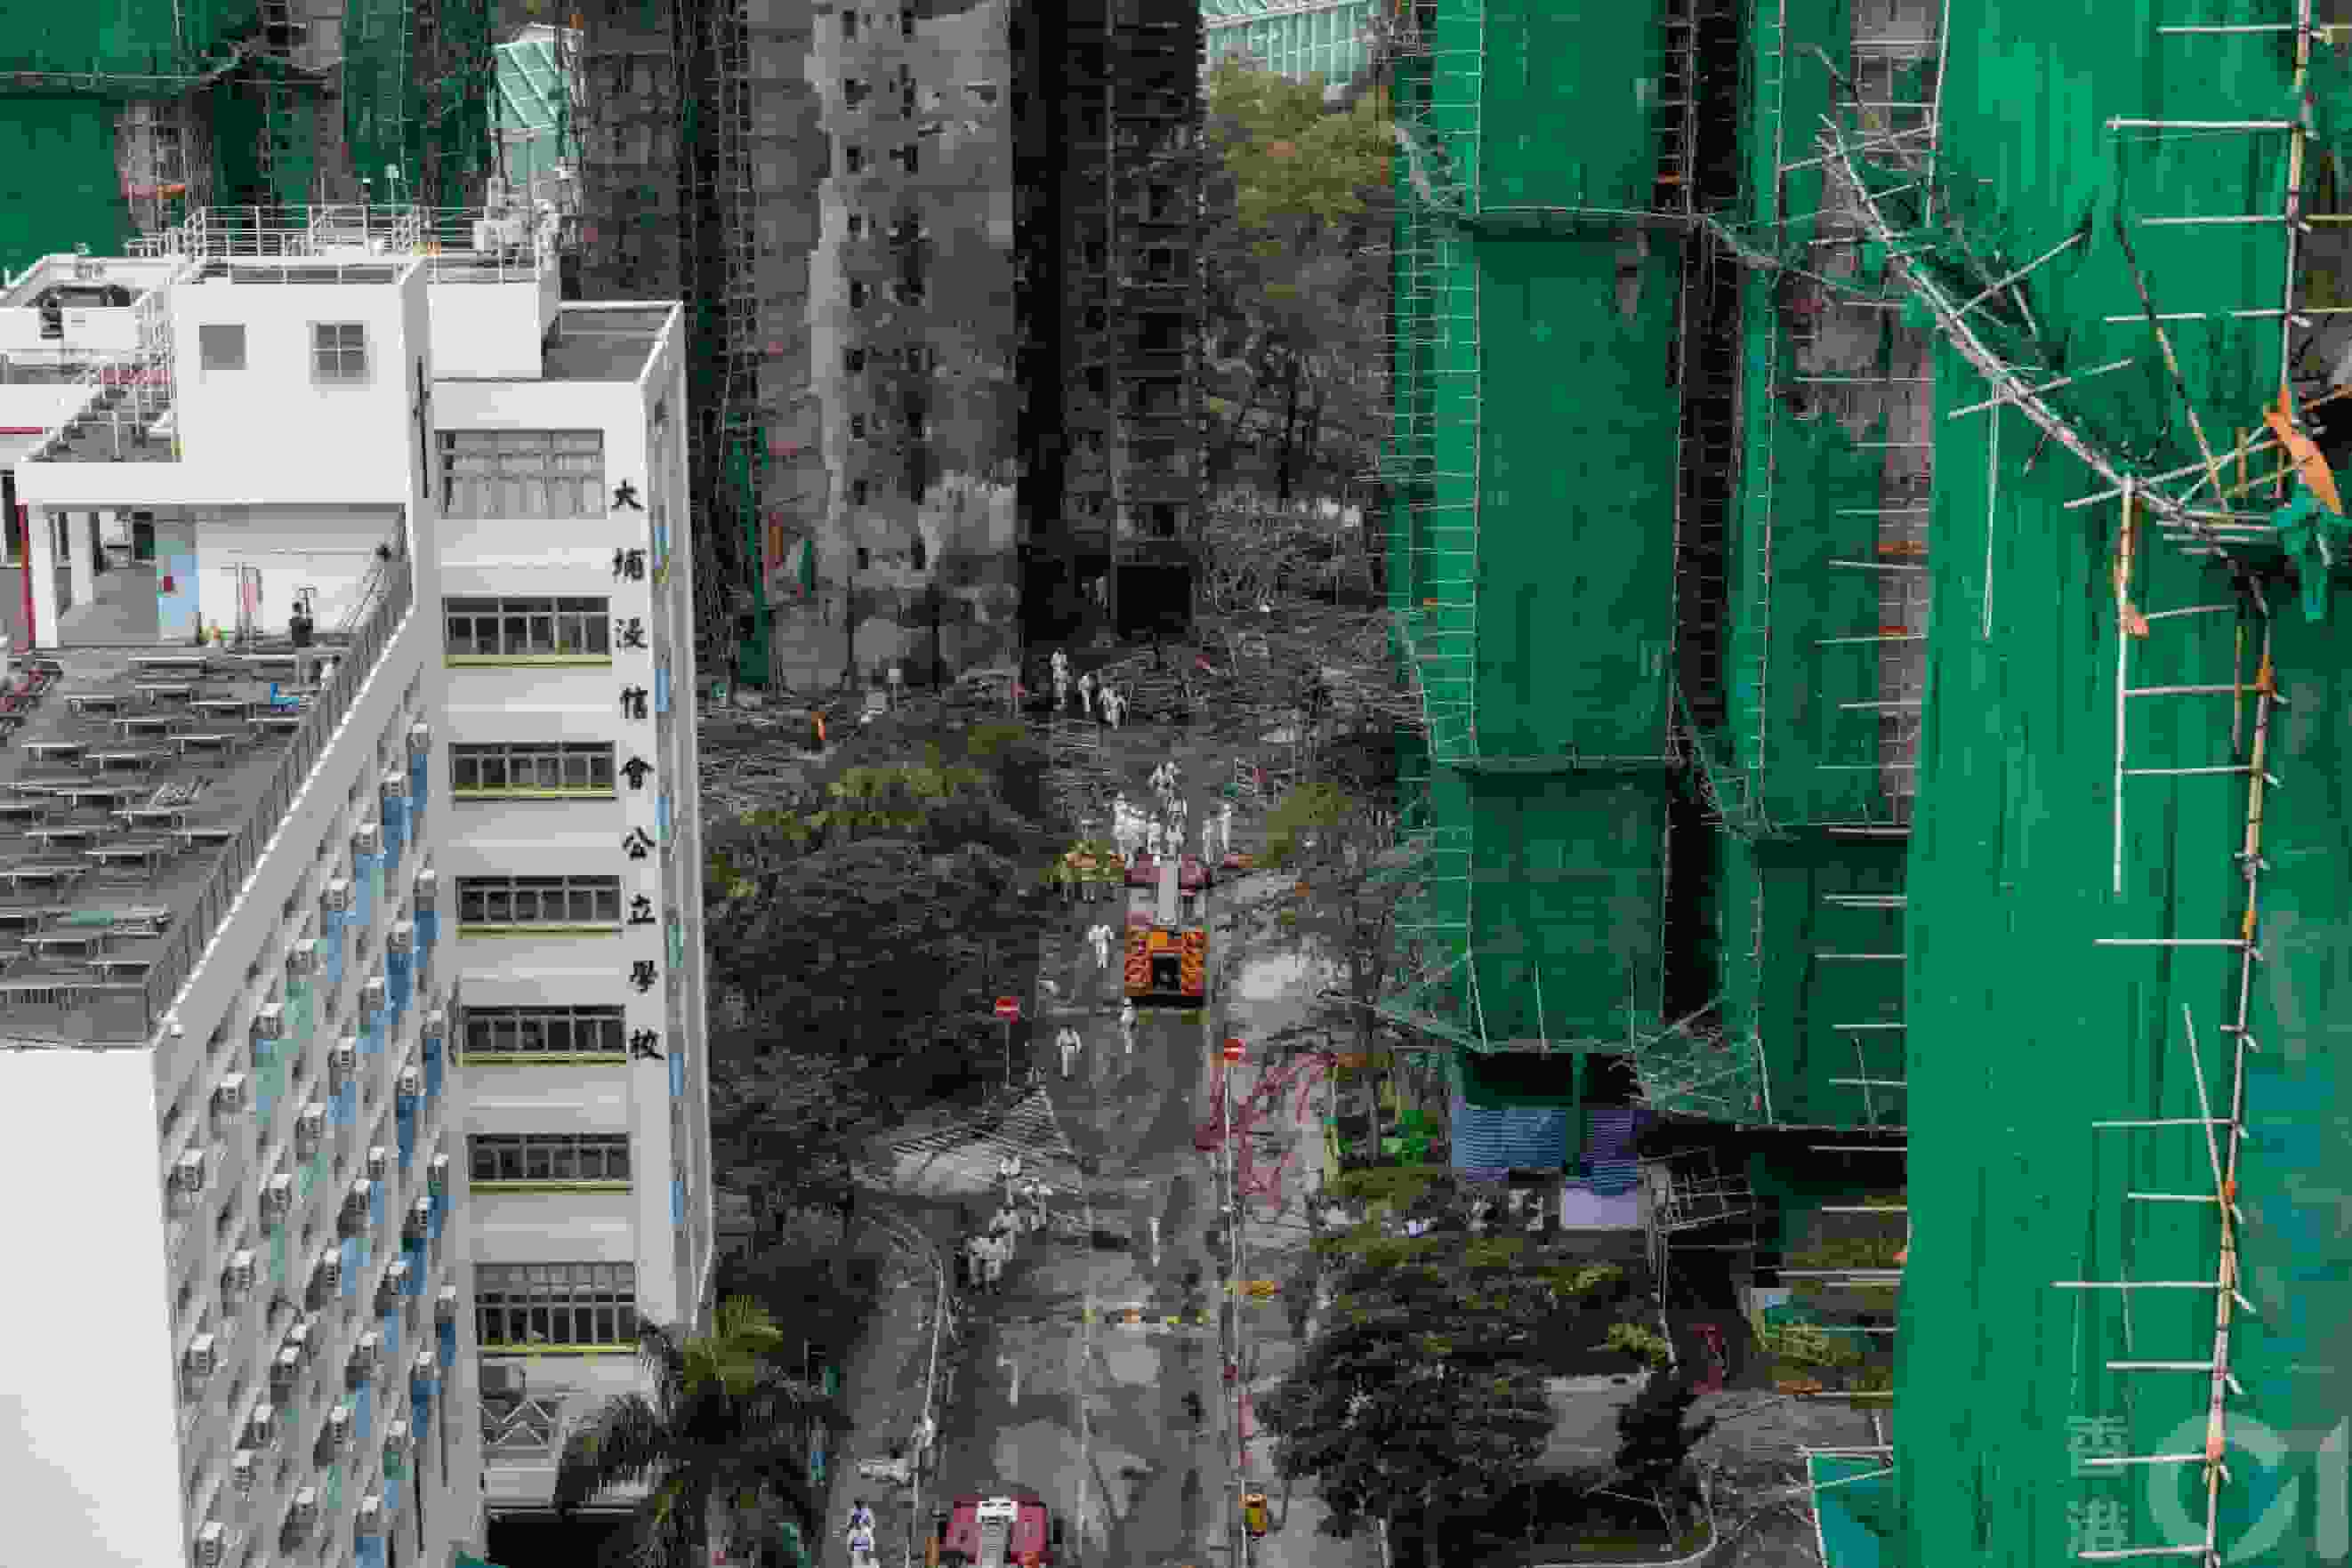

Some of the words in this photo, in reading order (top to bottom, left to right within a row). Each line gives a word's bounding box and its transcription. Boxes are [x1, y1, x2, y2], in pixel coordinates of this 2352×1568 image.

[611, 478, 665, 1060] 大埔浸信會公立學校
